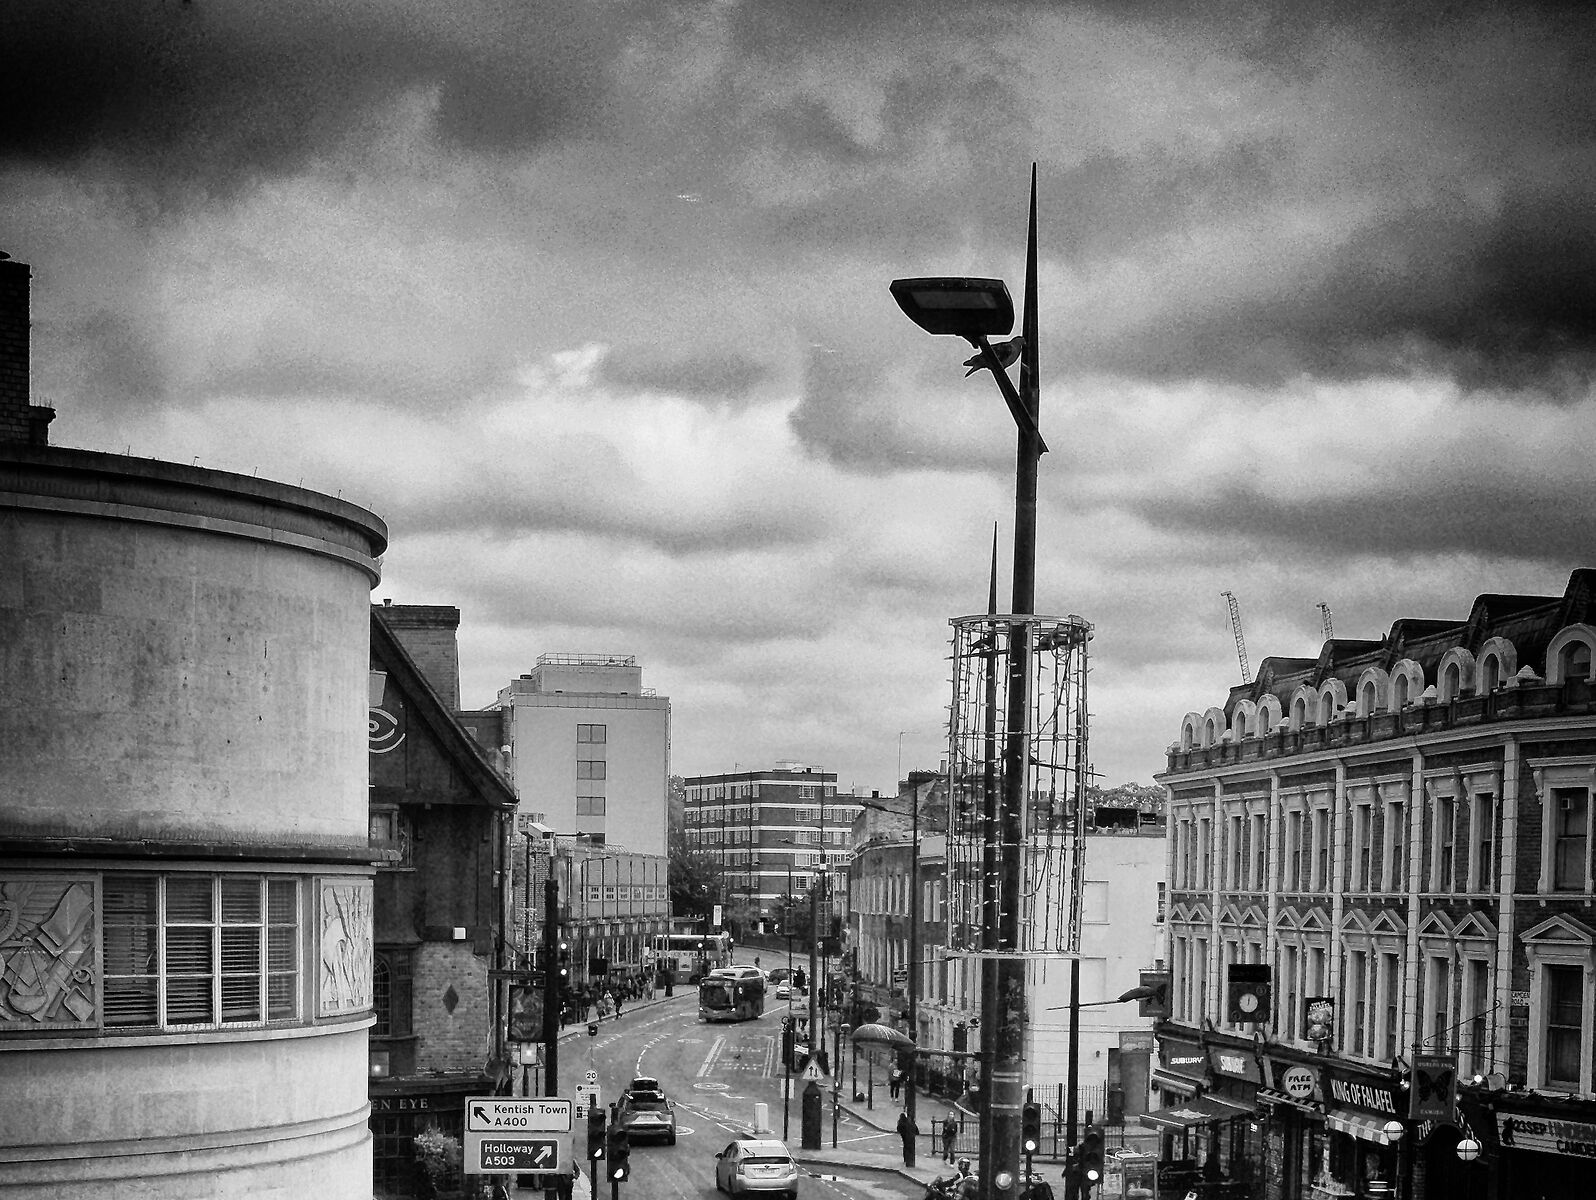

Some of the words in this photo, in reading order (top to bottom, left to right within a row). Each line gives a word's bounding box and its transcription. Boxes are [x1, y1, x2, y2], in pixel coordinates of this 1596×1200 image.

[1331, 1079, 1351, 1103] KING
[1351, 1083, 1361, 1105] OF
[1361, 1085, 1396, 1114] FALAFEL
[399, 1098, 429, 1109] EYE
[494, 1105, 534, 1114] Kentish
[539, 1105, 567, 1114] Town
[494, 1118, 528, 1126] A400
[484, 1144, 534, 1155] Holloway
[485, 1156, 515, 1166] A503
